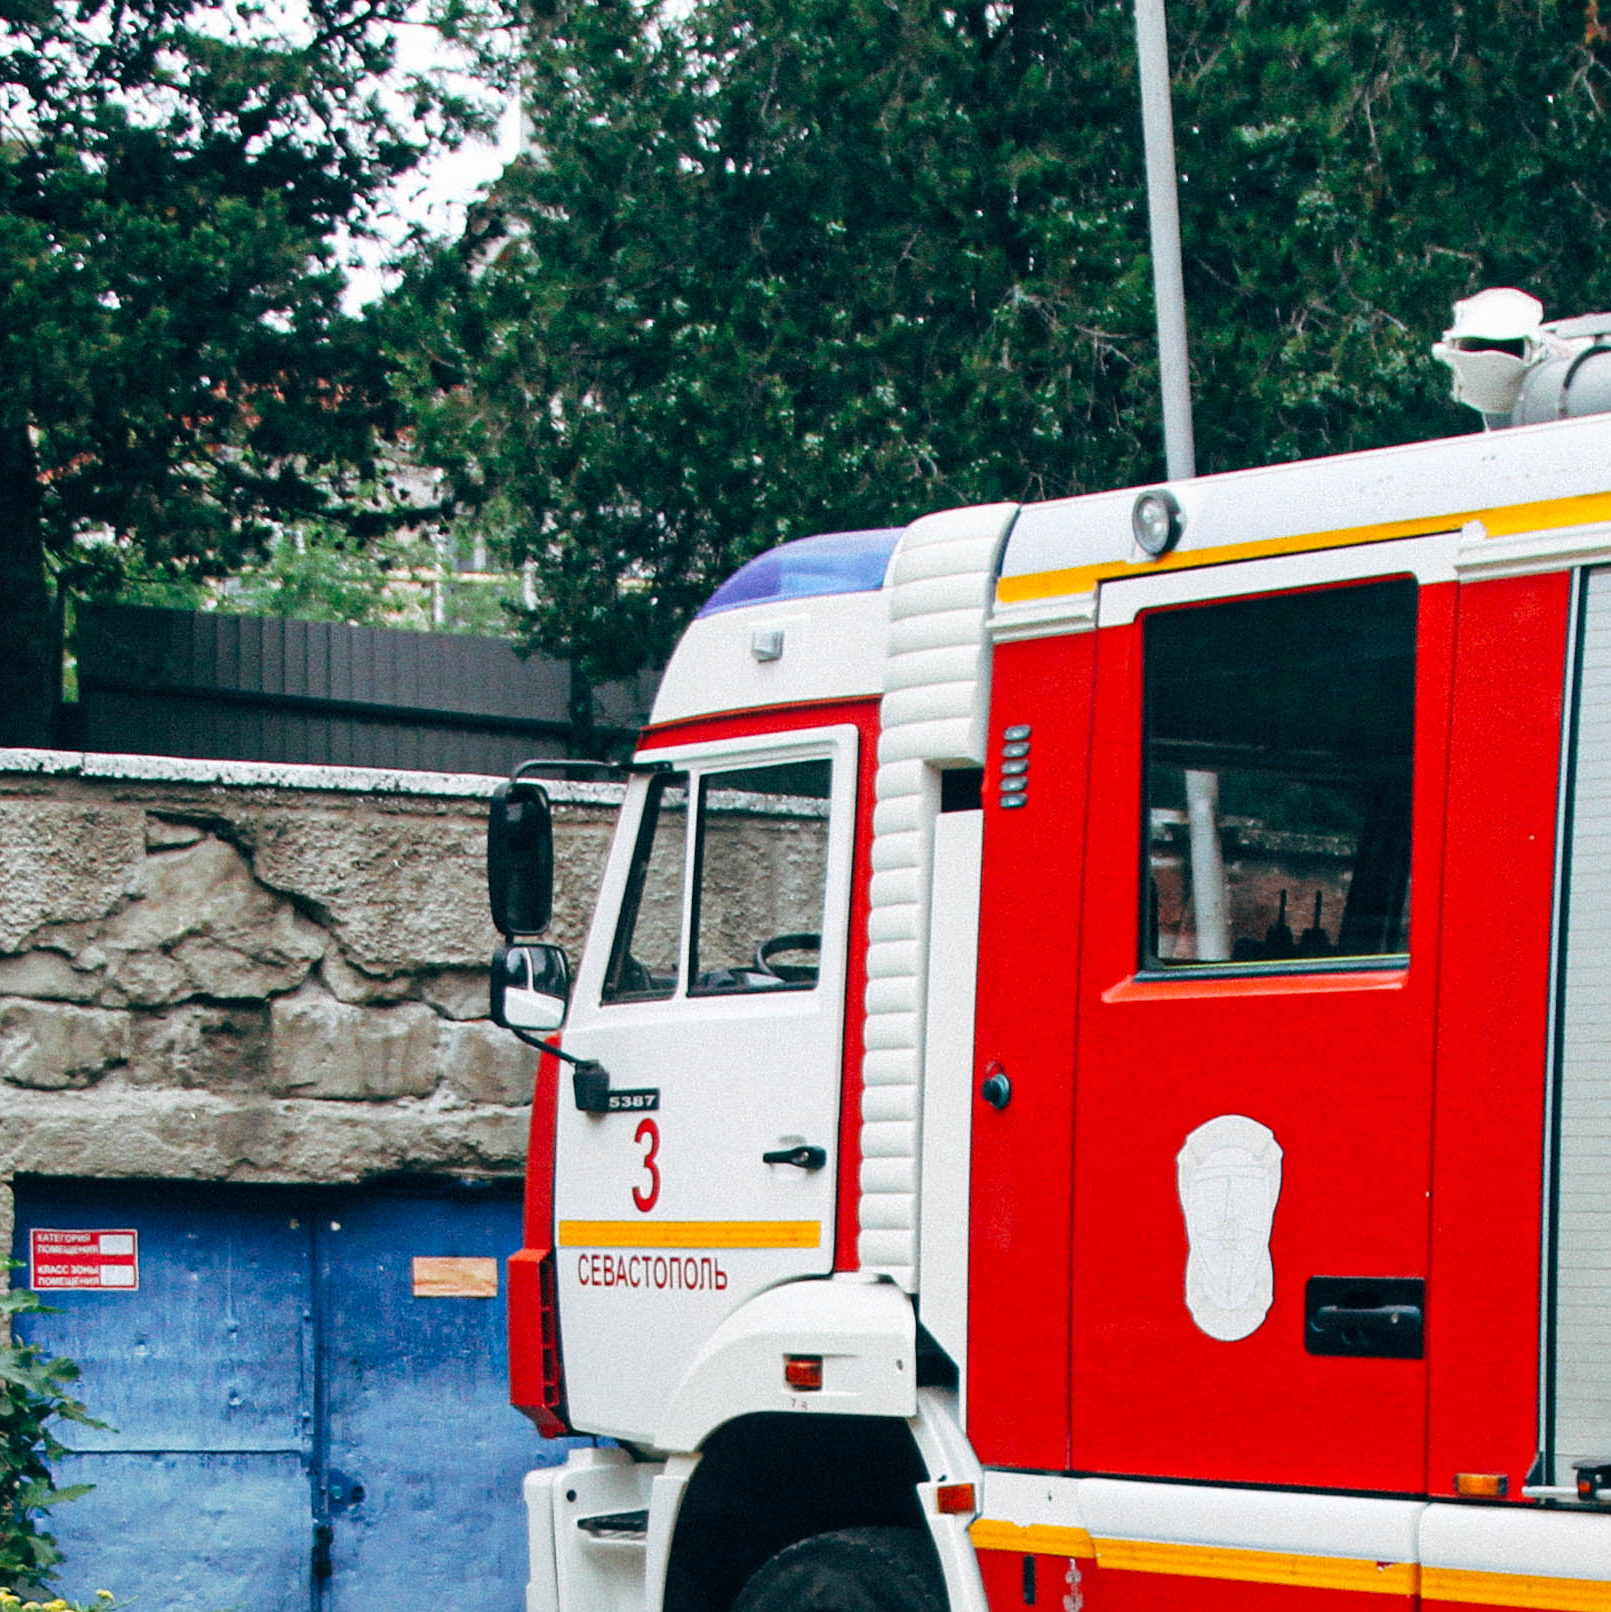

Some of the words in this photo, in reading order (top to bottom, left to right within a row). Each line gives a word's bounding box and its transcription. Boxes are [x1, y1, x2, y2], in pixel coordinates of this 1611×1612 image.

[608, 1095, 656, 1108] 5387
[631, 1117, 660, 1212] 3
[37, 1233, 91, 1243] КАТЕГОРИЯ
[37, 1244, 99, 1254] ПОМЕЩЕНИЯ
[37, 1265, 70, 1275] КЛАСС
[70, 1265, 99, 1275] ЗОНЫ
[578, 1253, 728, 1291] СЕВАСТОПОЛЬ
[38, 1276, 99, 1286] ПОМЕЩЕНИЯ
